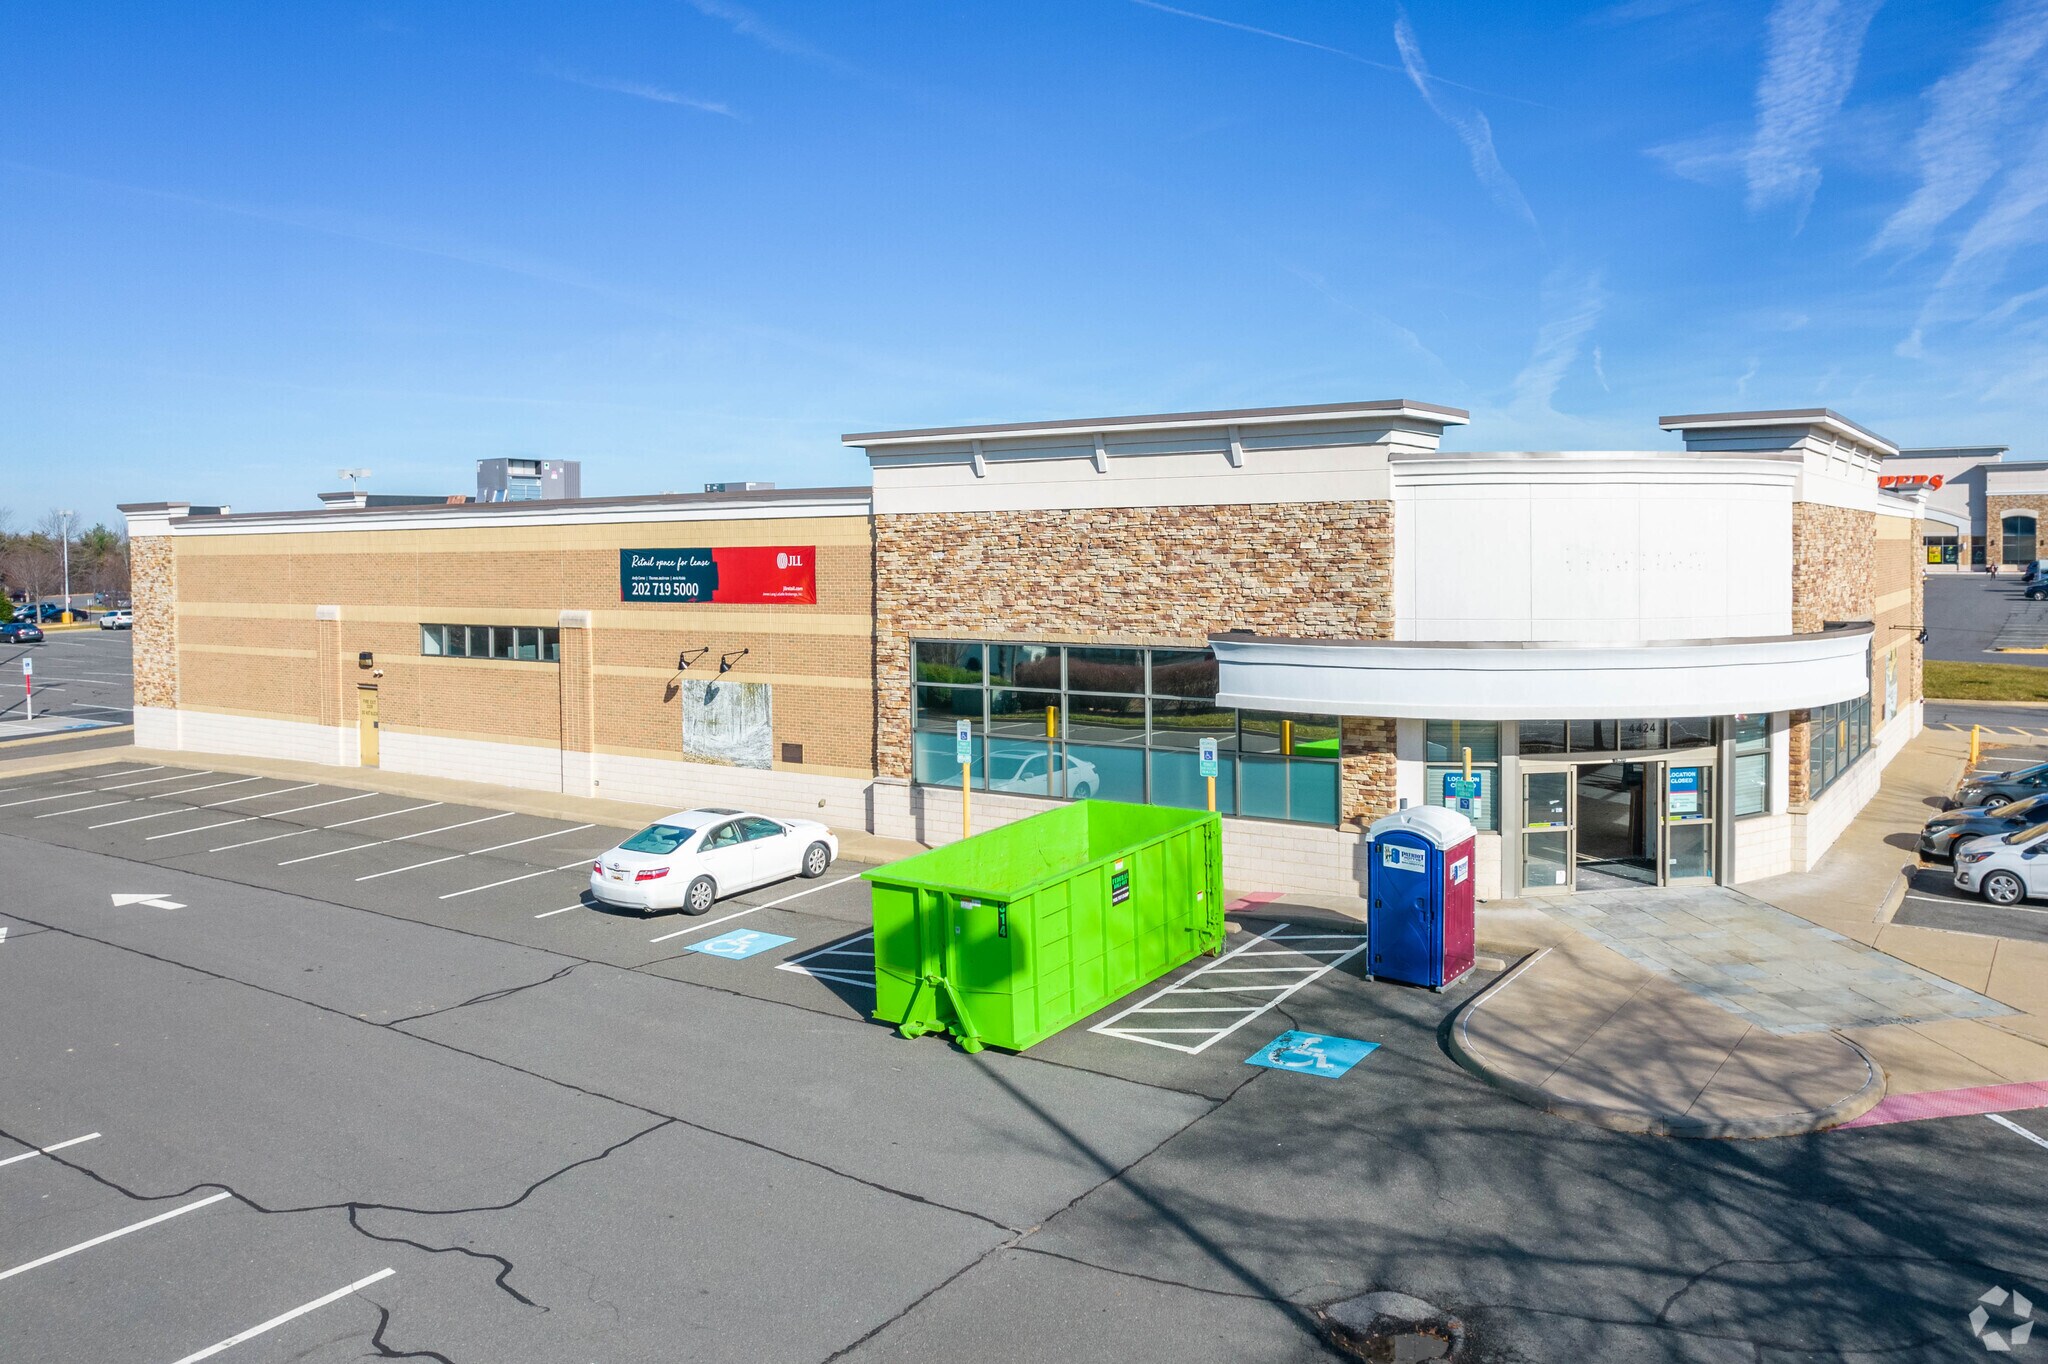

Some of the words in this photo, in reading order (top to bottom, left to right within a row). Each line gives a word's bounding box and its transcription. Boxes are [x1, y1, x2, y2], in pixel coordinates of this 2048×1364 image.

[1877, 474, 1944, 491] PERS
[632, 555, 654, 568] Retail
[656, 560, 676, 570] space
[677, 556, 688, 571] for
[690, 556, 710, 567] lease
[788, 555, 803, 566] JLL
[632, 582, 651, 595] 202
[652, 583, 671, 595] 719
[673, 583, 699, 596] 5000
[1629, 722, 1656, 733] 4424
